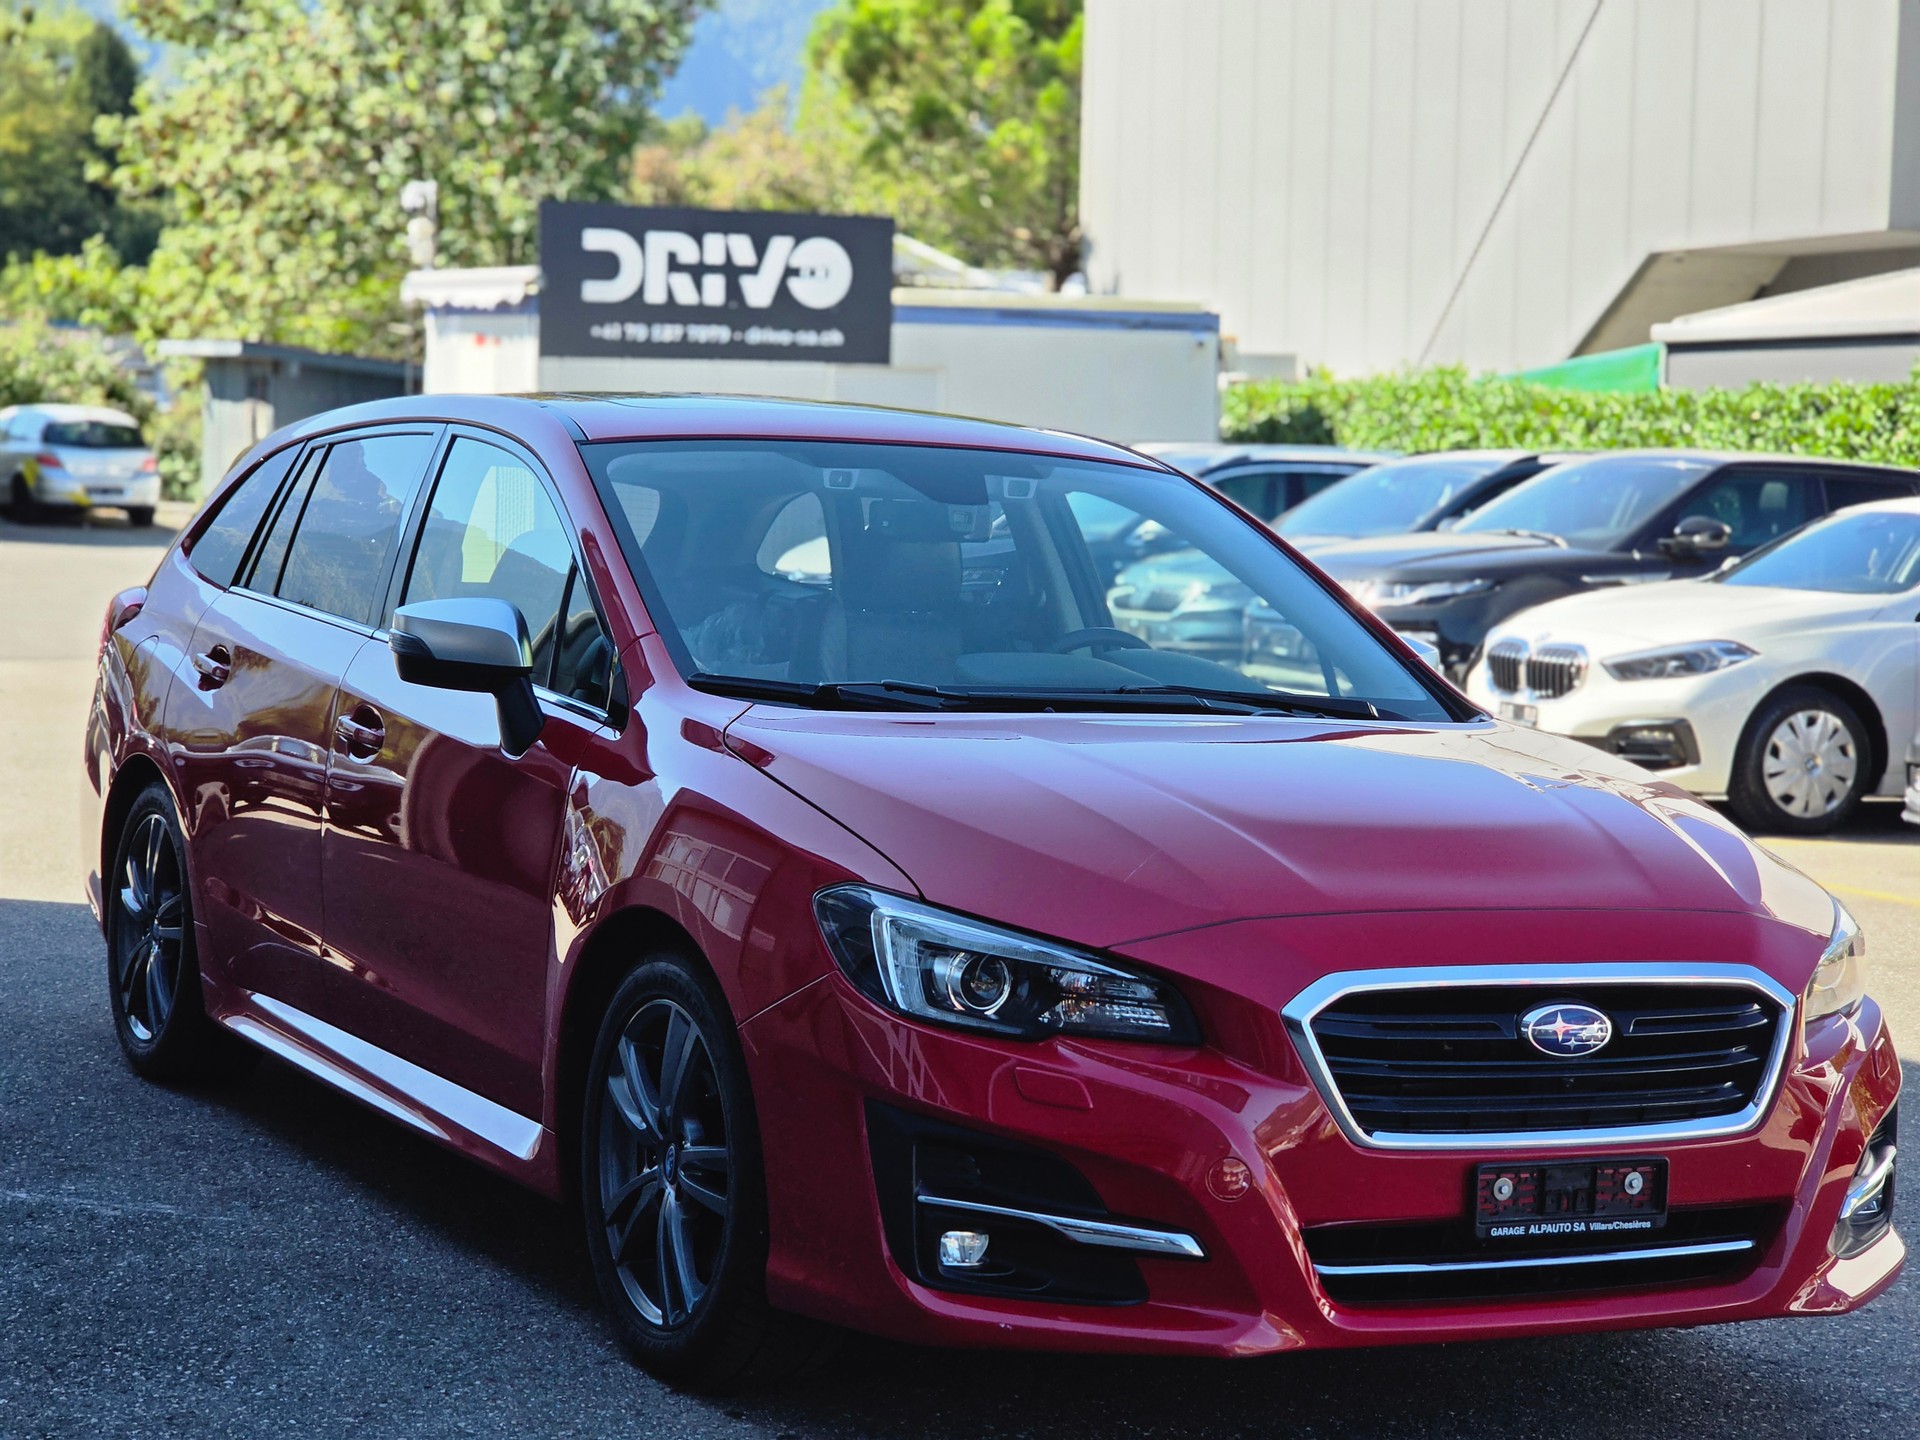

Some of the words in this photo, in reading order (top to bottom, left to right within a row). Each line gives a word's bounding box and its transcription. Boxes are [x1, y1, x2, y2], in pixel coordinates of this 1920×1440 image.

[581, 228, 852, 309] DRIVO
[1490, 1225, 1526, 1237] GARAGE
[1528, 1222, 1571, 1235] ALPAUTO
[1572, 1221, 1586, 1232] SA
